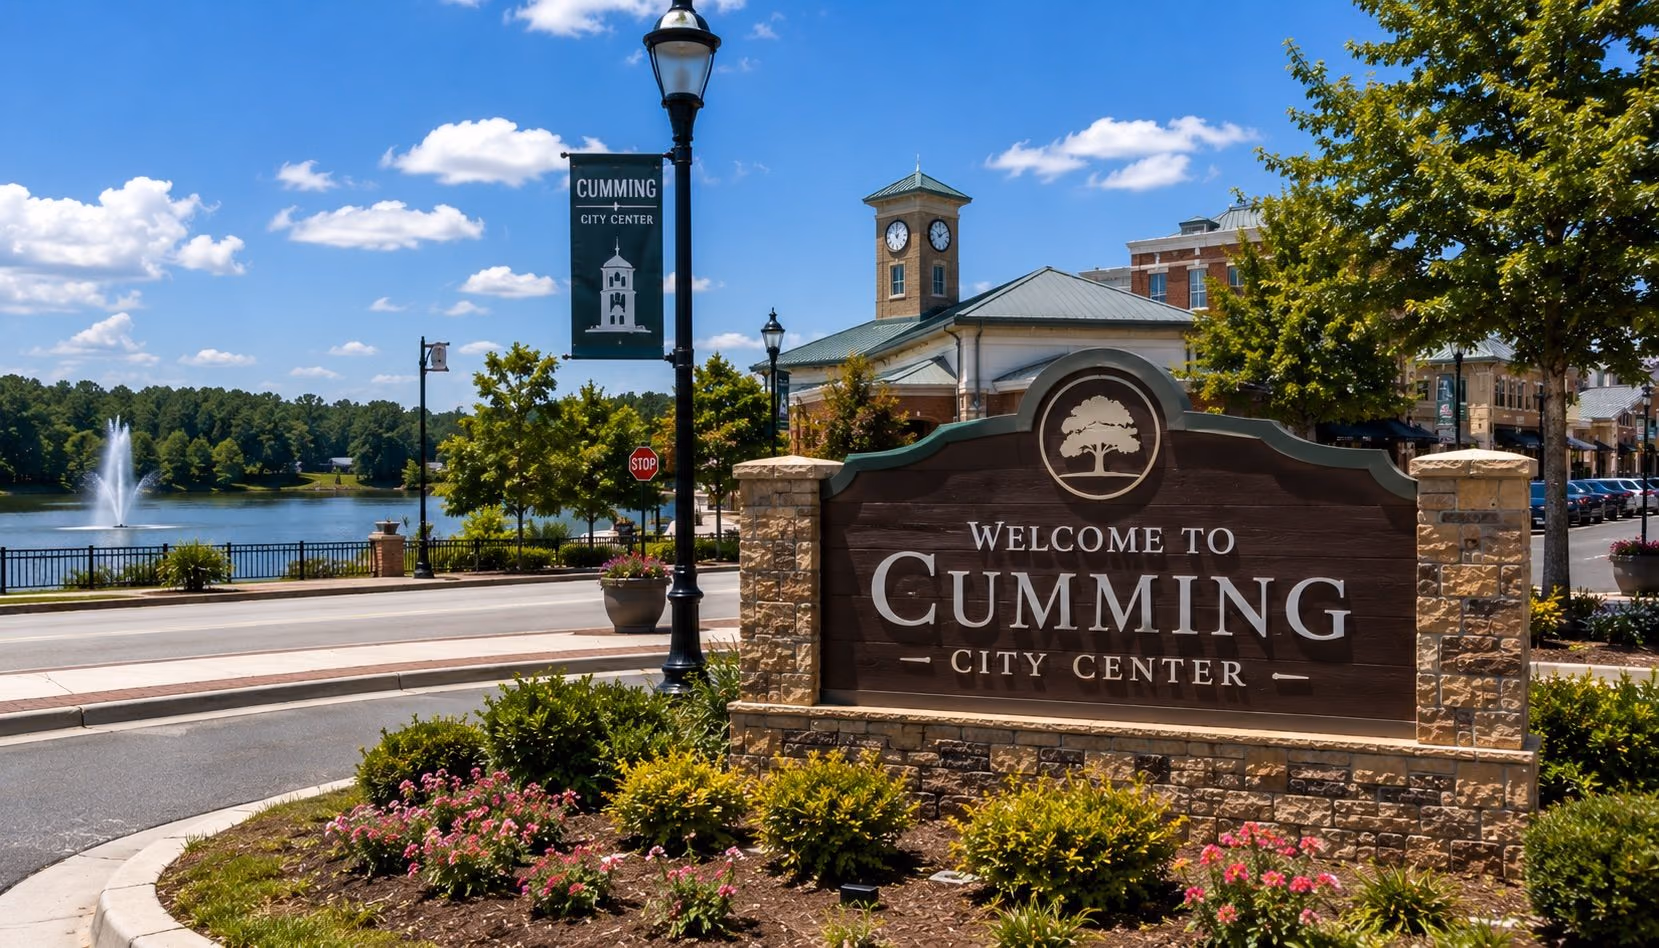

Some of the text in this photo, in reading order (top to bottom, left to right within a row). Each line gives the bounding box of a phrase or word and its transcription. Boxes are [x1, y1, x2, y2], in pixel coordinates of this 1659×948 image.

[577, 178, 656, 198] CUMMING
[581, 214, 653, 225] CITY CENTER
[631, 457, 656, 471] STOP
[1181, 527, 1235, 555] TO
[871, 551, 1351, 641] CUMMING
[951, 649, 1246, 687] CITY CENTER
